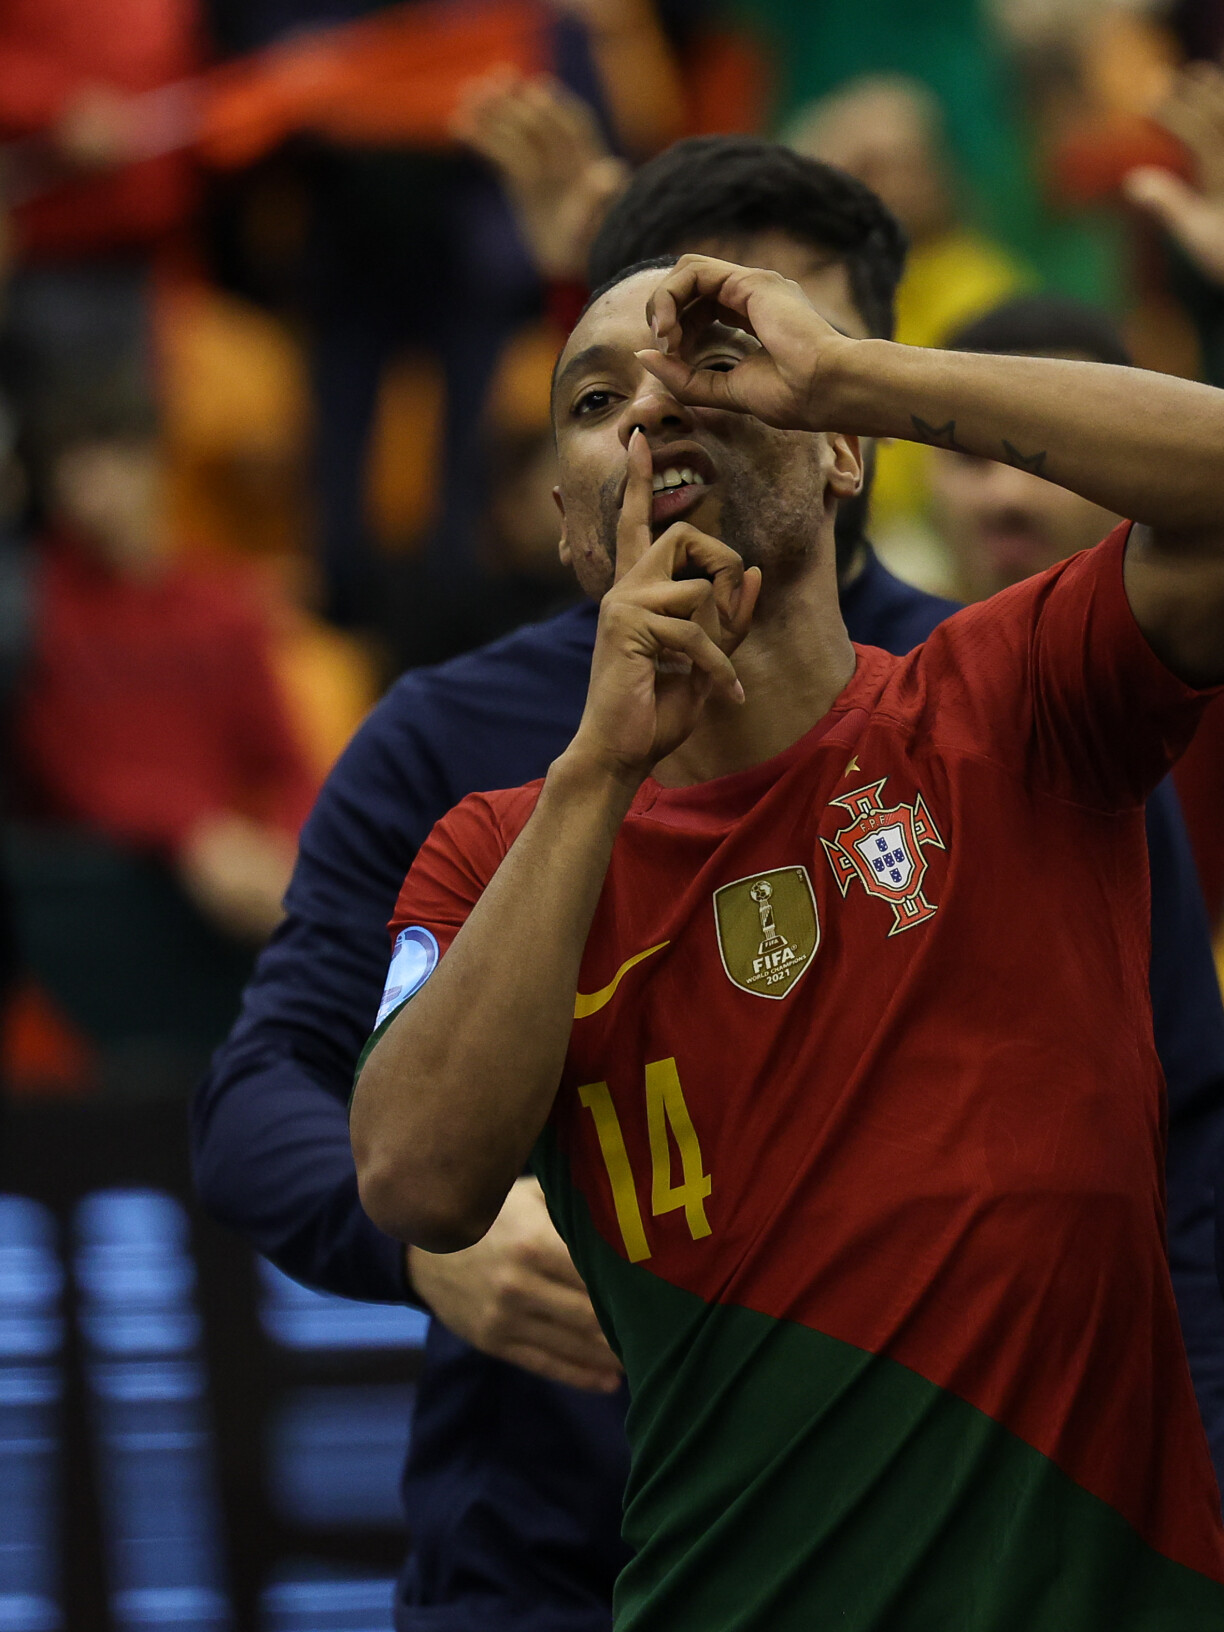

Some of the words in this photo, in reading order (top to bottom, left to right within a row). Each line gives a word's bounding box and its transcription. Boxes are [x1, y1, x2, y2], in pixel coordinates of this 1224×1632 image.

[765, 939, 779, 947] FIFA
[746, 971, 769, 984] WORLD
[770, 954, 807, 974] CHAMPIONS
[766, 968, 790, 985] 2021
[578, 1057, 712, 1263] 14
